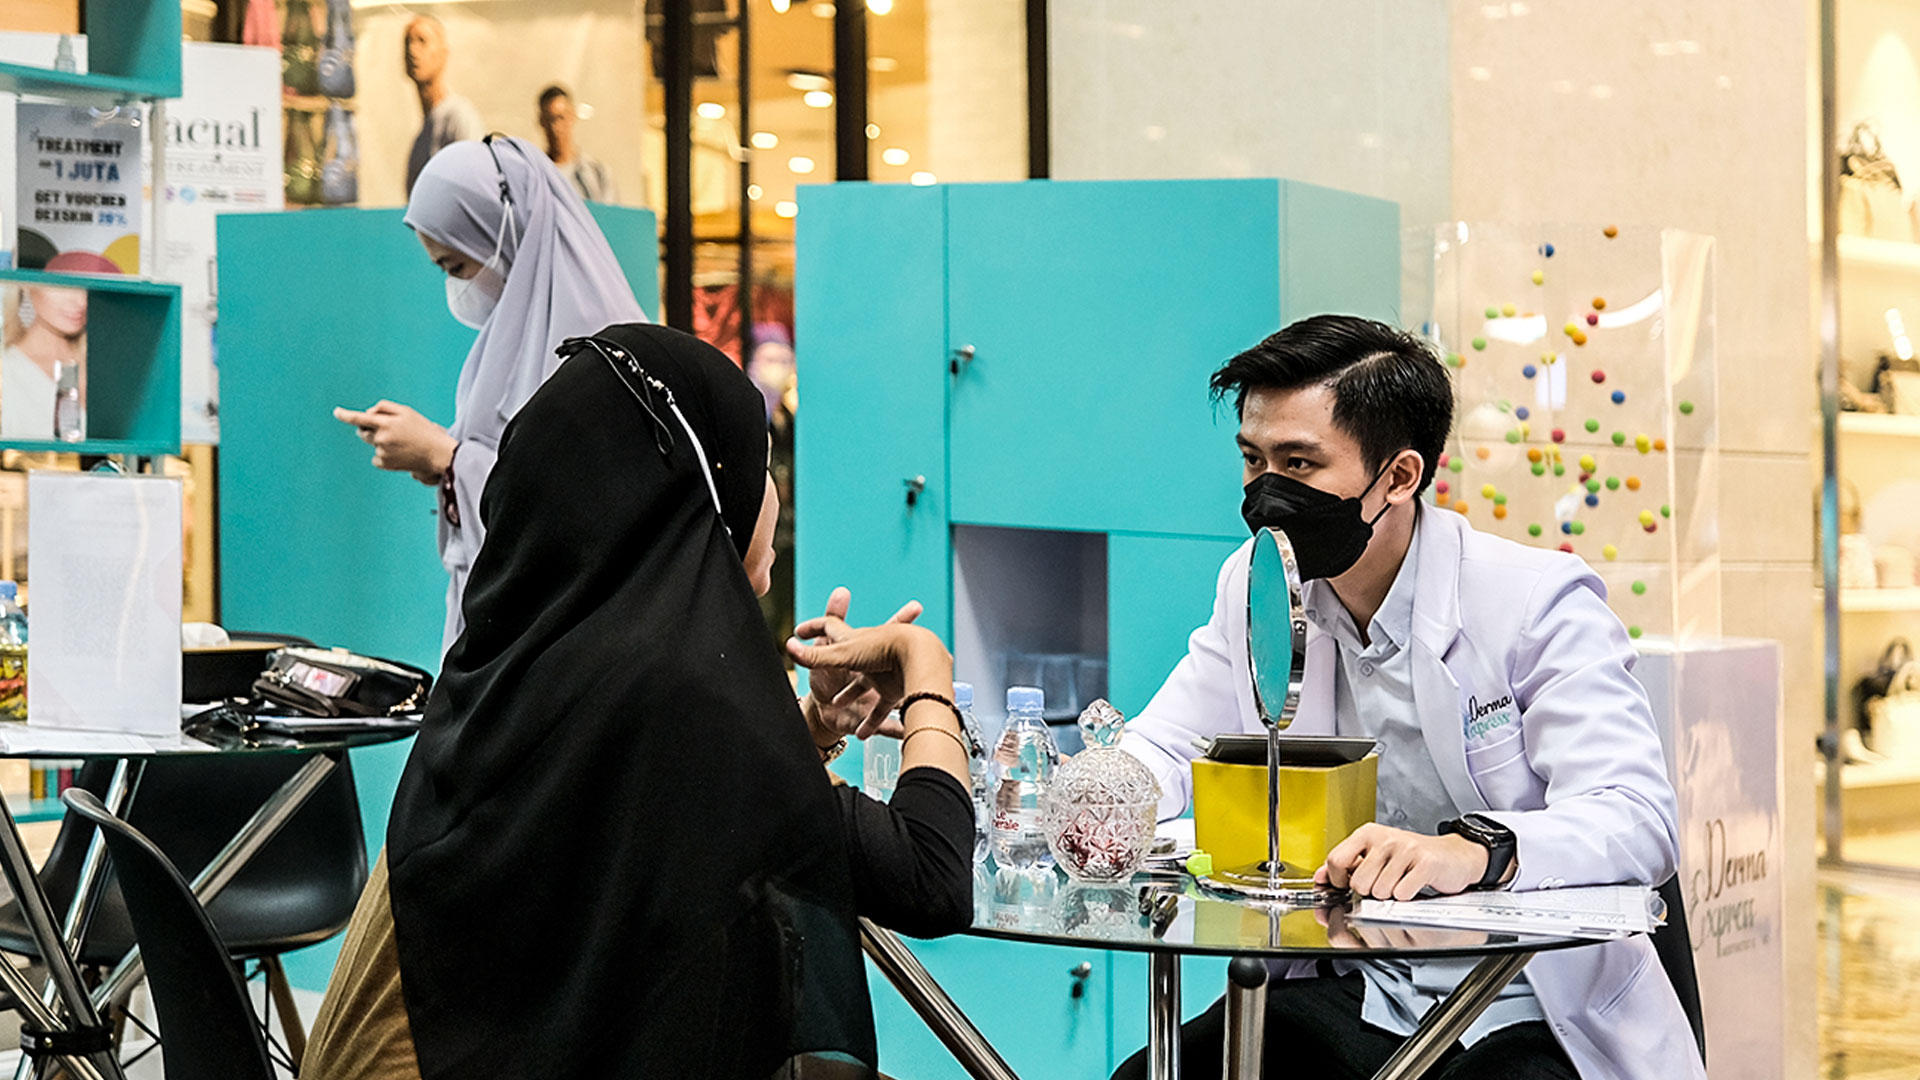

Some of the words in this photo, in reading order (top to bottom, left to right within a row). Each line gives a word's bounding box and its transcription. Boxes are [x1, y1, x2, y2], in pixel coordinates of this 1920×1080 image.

[165, 107, 260, 149] acial
[37, 136, 123, 156] TREATMENT
[68, 161, 120, 181] JUTA
[34, 189, 59, 204] GET
[65, 191, 127, 207] VOUCHER
[1468, 695, 1513, 724] Derma
[992, 818, 1019, 831] nerale
[1704, 818, 1767, 902] Derma
